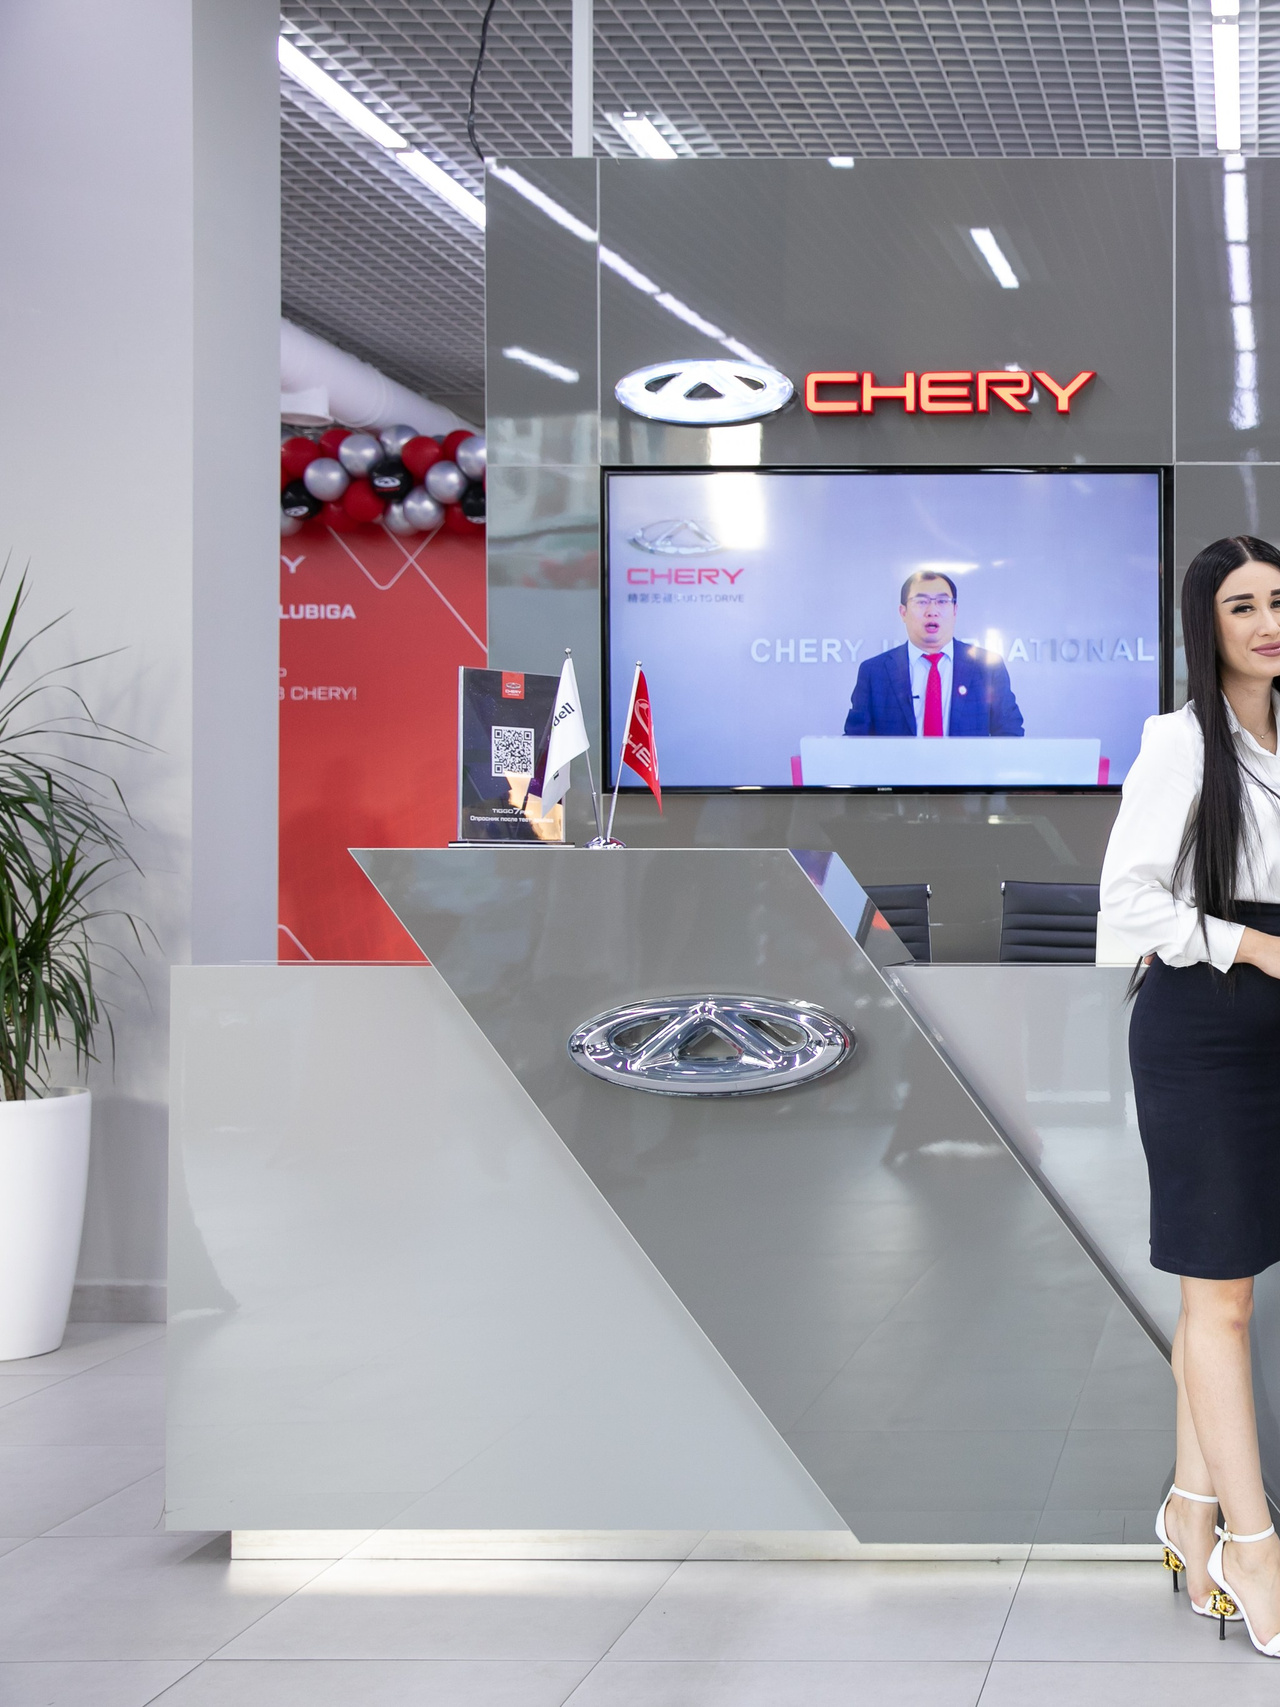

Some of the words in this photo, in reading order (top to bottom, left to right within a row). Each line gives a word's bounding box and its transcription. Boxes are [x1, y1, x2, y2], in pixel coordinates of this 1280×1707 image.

[804, 370, 1097, 415] CHERY
[626, 568, 745, 585] CHERY
[714, 594, 744, 603] DRIVE
[750, 638, 864, 663] CHERY
[290, 686, 357, 701] CHERY!
